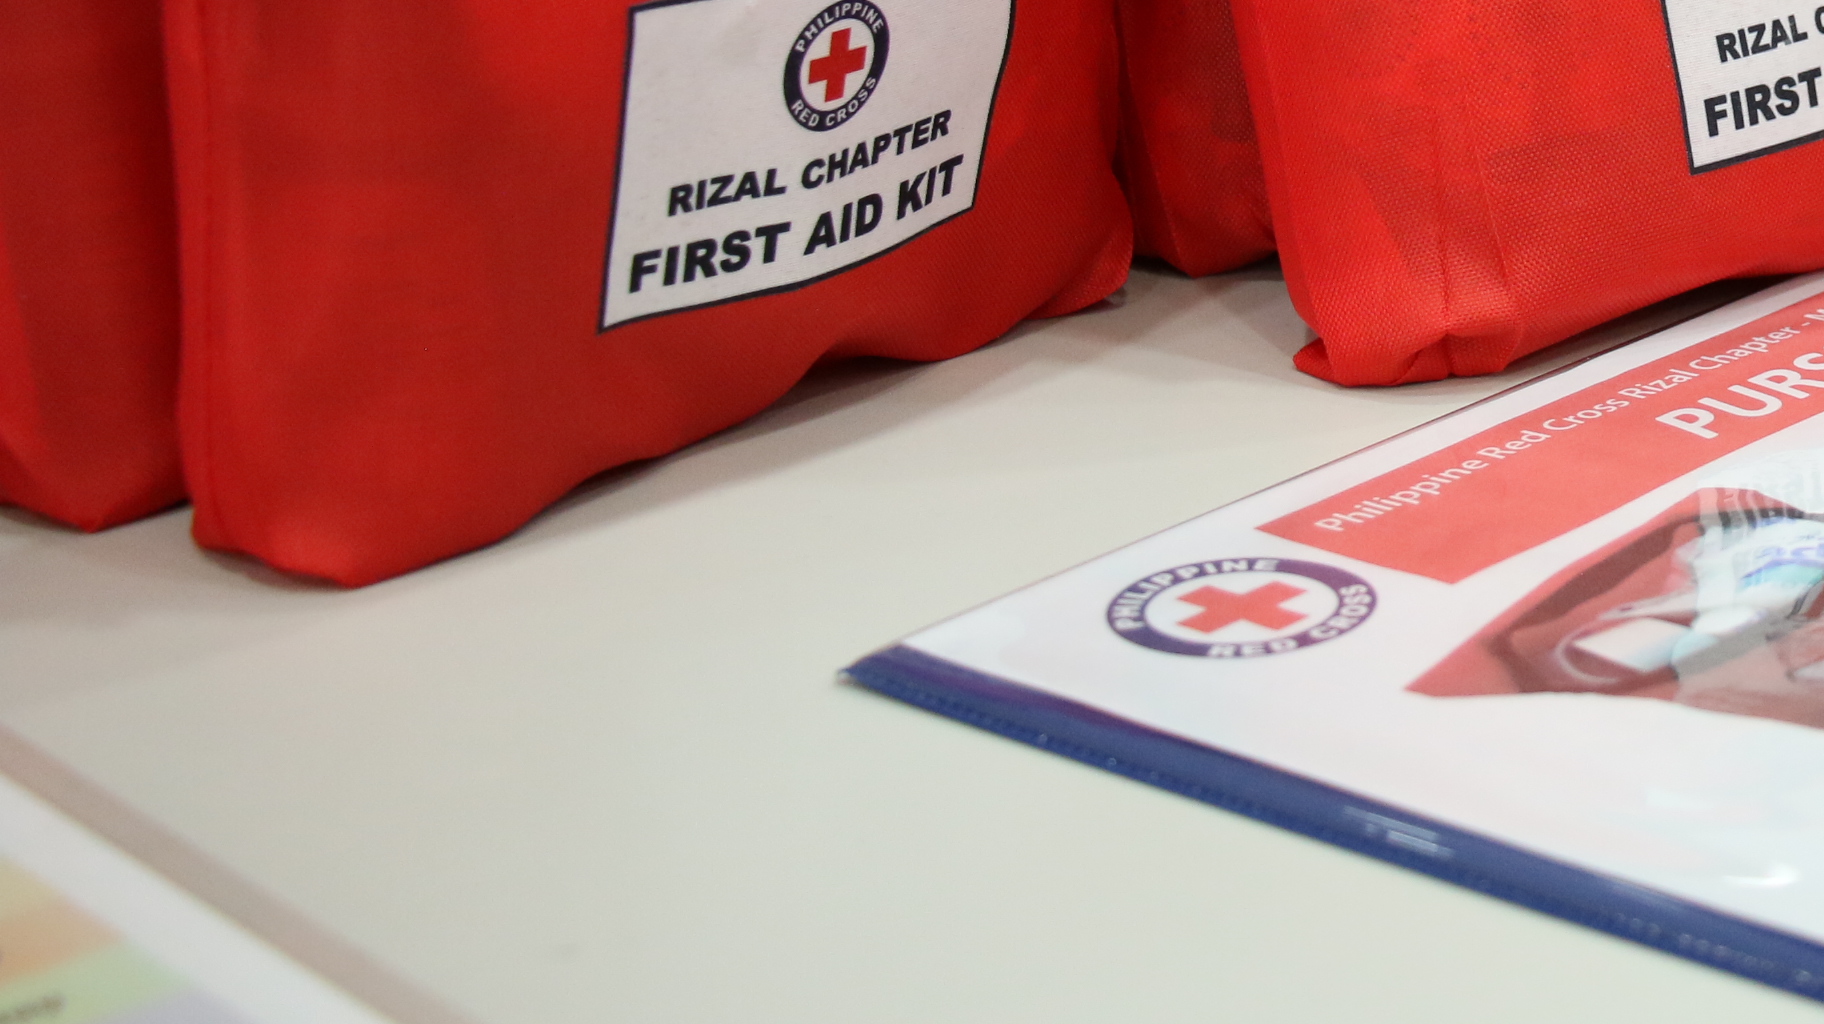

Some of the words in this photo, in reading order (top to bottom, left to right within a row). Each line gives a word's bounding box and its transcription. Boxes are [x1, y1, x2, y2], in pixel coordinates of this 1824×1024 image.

[794, 2, 884, 53] PHILIPPINE
[1716, 15, 1808, 63] RIZAL
[791, 99, 820, 127] RED
[825, 76, 877, 126] CROSS
[1703, 67, 1822, 138] FIRST
[667, 168, 787, 217] RIZAL
[801, 109, 952, 190] CHAPTER
[628, 222, 791, 294] FIRST
[803, 193, 884, 257] AID
[896, 154, 964, 221] KIT
[1314, 458, 1489, 532] Philippine
[1477, 429, 1551, 460] Red
[1542, 397, 1631, 431] Cross
[1617, 368, 1700, 400] Rizal
[1689, 326, 1801, 370] Chapter
[1112, 558, 1281, 631] PHILIPPINE
[1206, 636, 1299, 659] RED
[1309, 583, 1374, 640] CROSS
